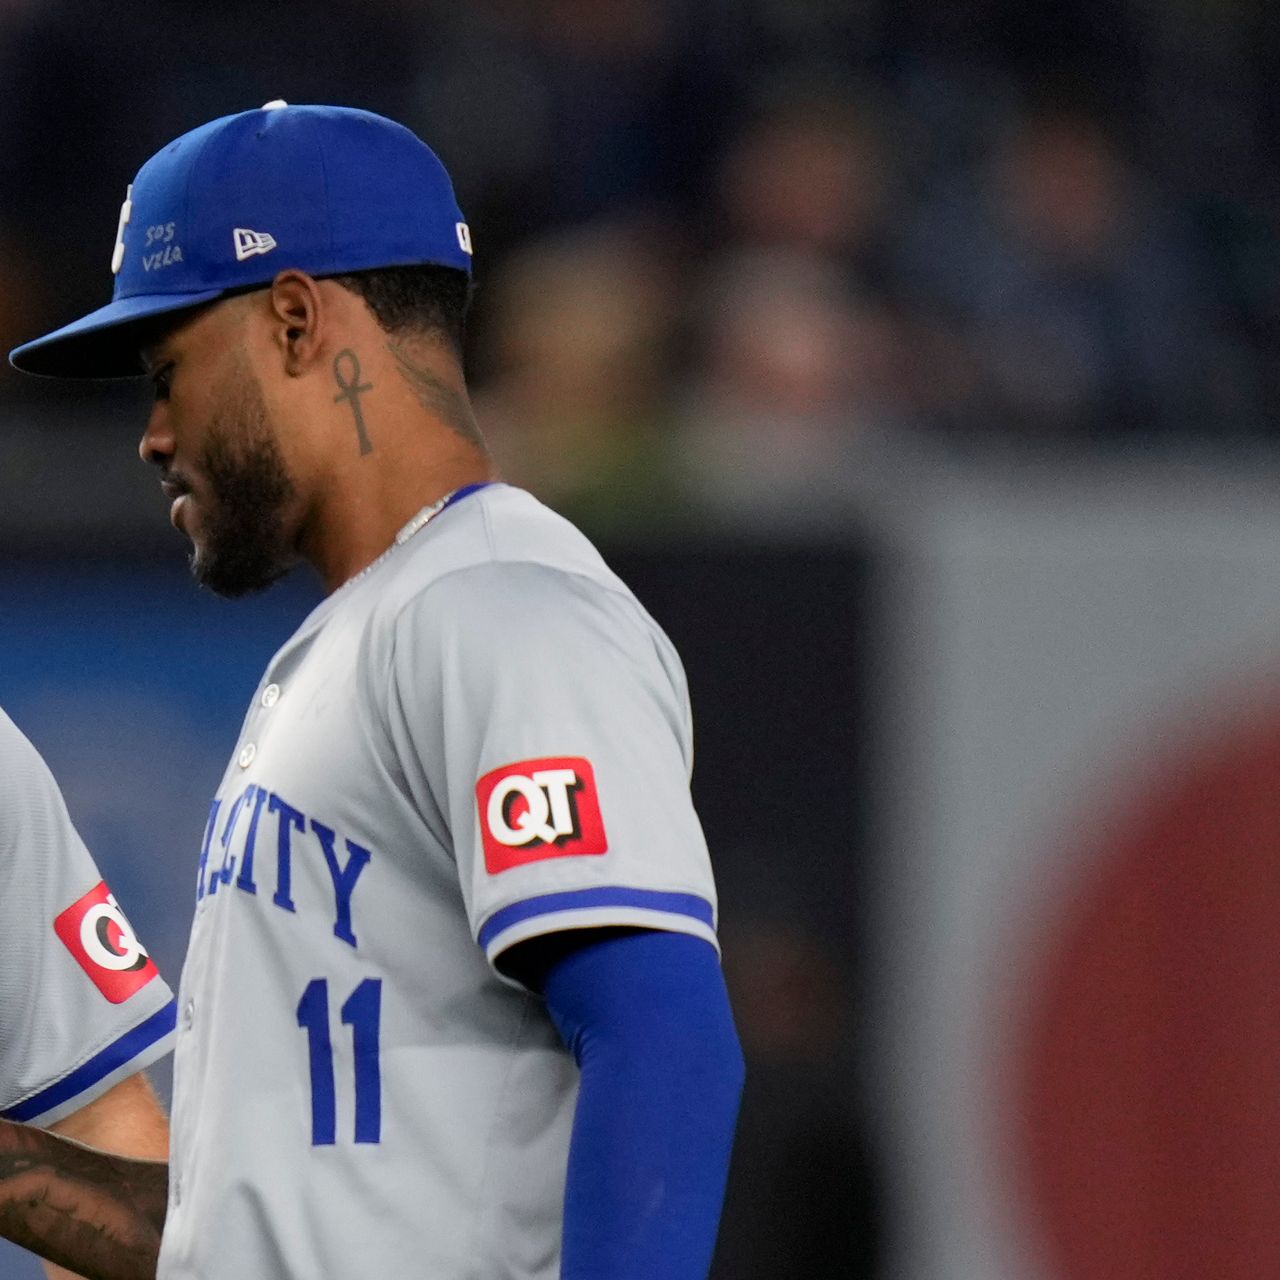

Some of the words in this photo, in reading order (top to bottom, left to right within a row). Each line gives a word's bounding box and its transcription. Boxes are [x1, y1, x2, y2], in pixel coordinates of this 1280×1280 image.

[486, 768, 577, 847] QT
[80, 893, 150, 971] Q
[297, 977, 382, 1147] 11
